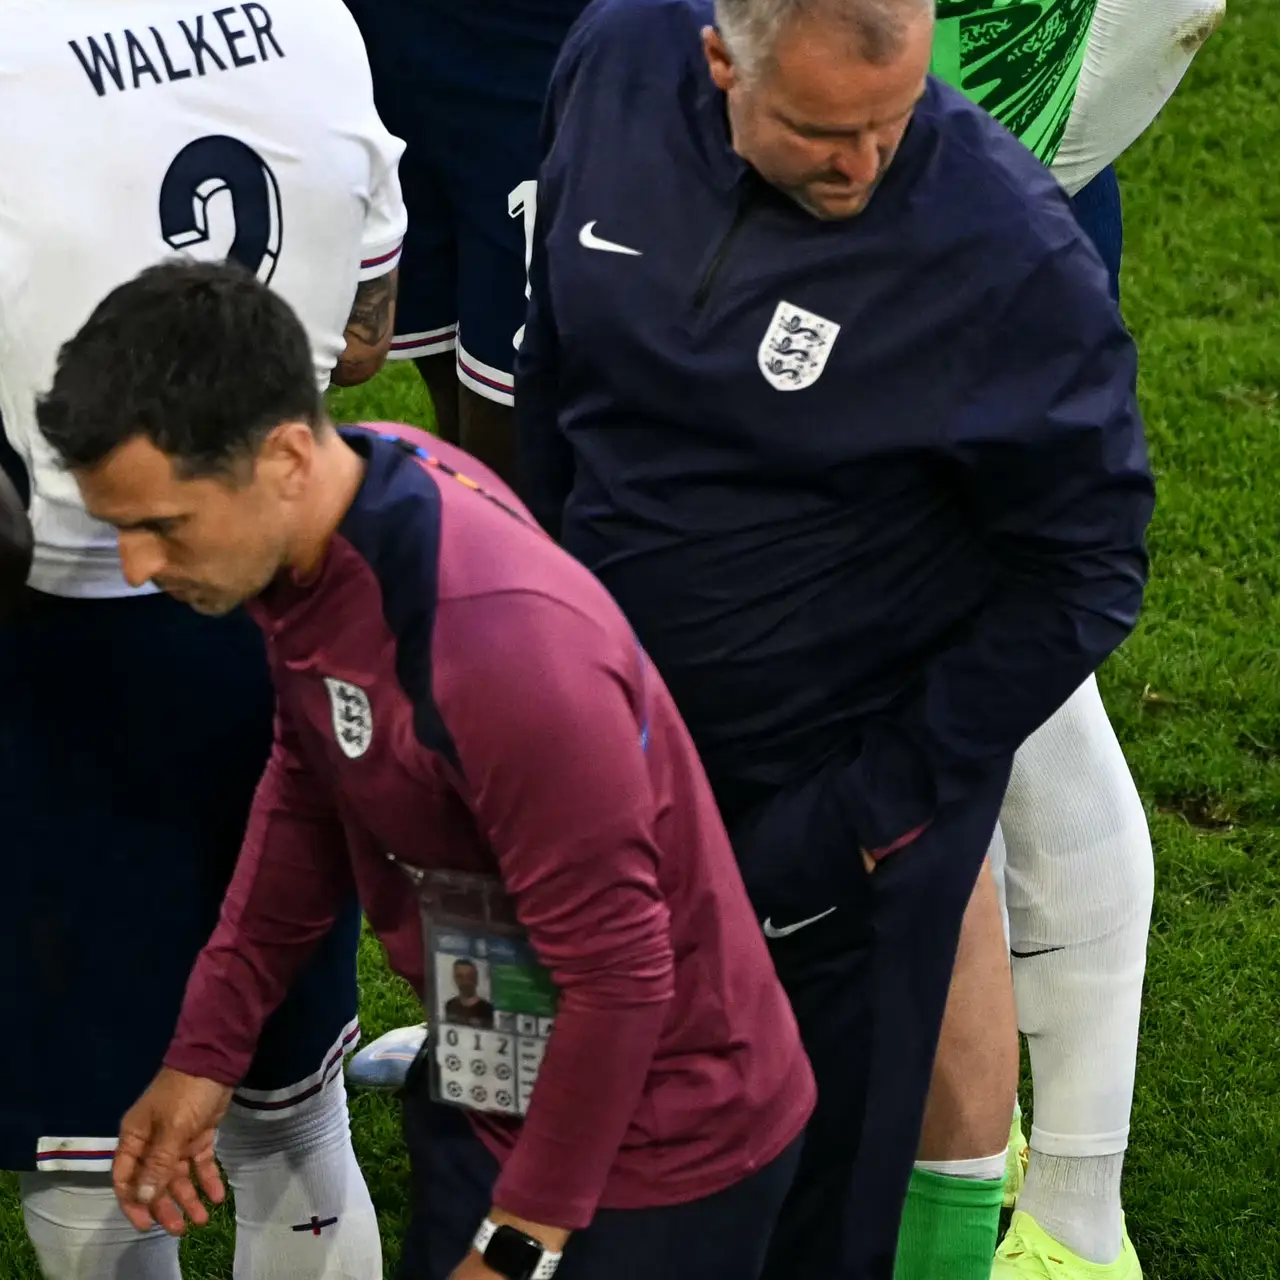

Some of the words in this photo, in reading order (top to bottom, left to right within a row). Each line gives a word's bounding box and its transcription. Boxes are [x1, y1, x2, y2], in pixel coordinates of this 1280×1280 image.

[68, 1, 286, 97] WALKER
[158, 134, 283, 286] 2
[446, 1028, 459, 1047] 0
[473, 1034, 482, 1051] 1
